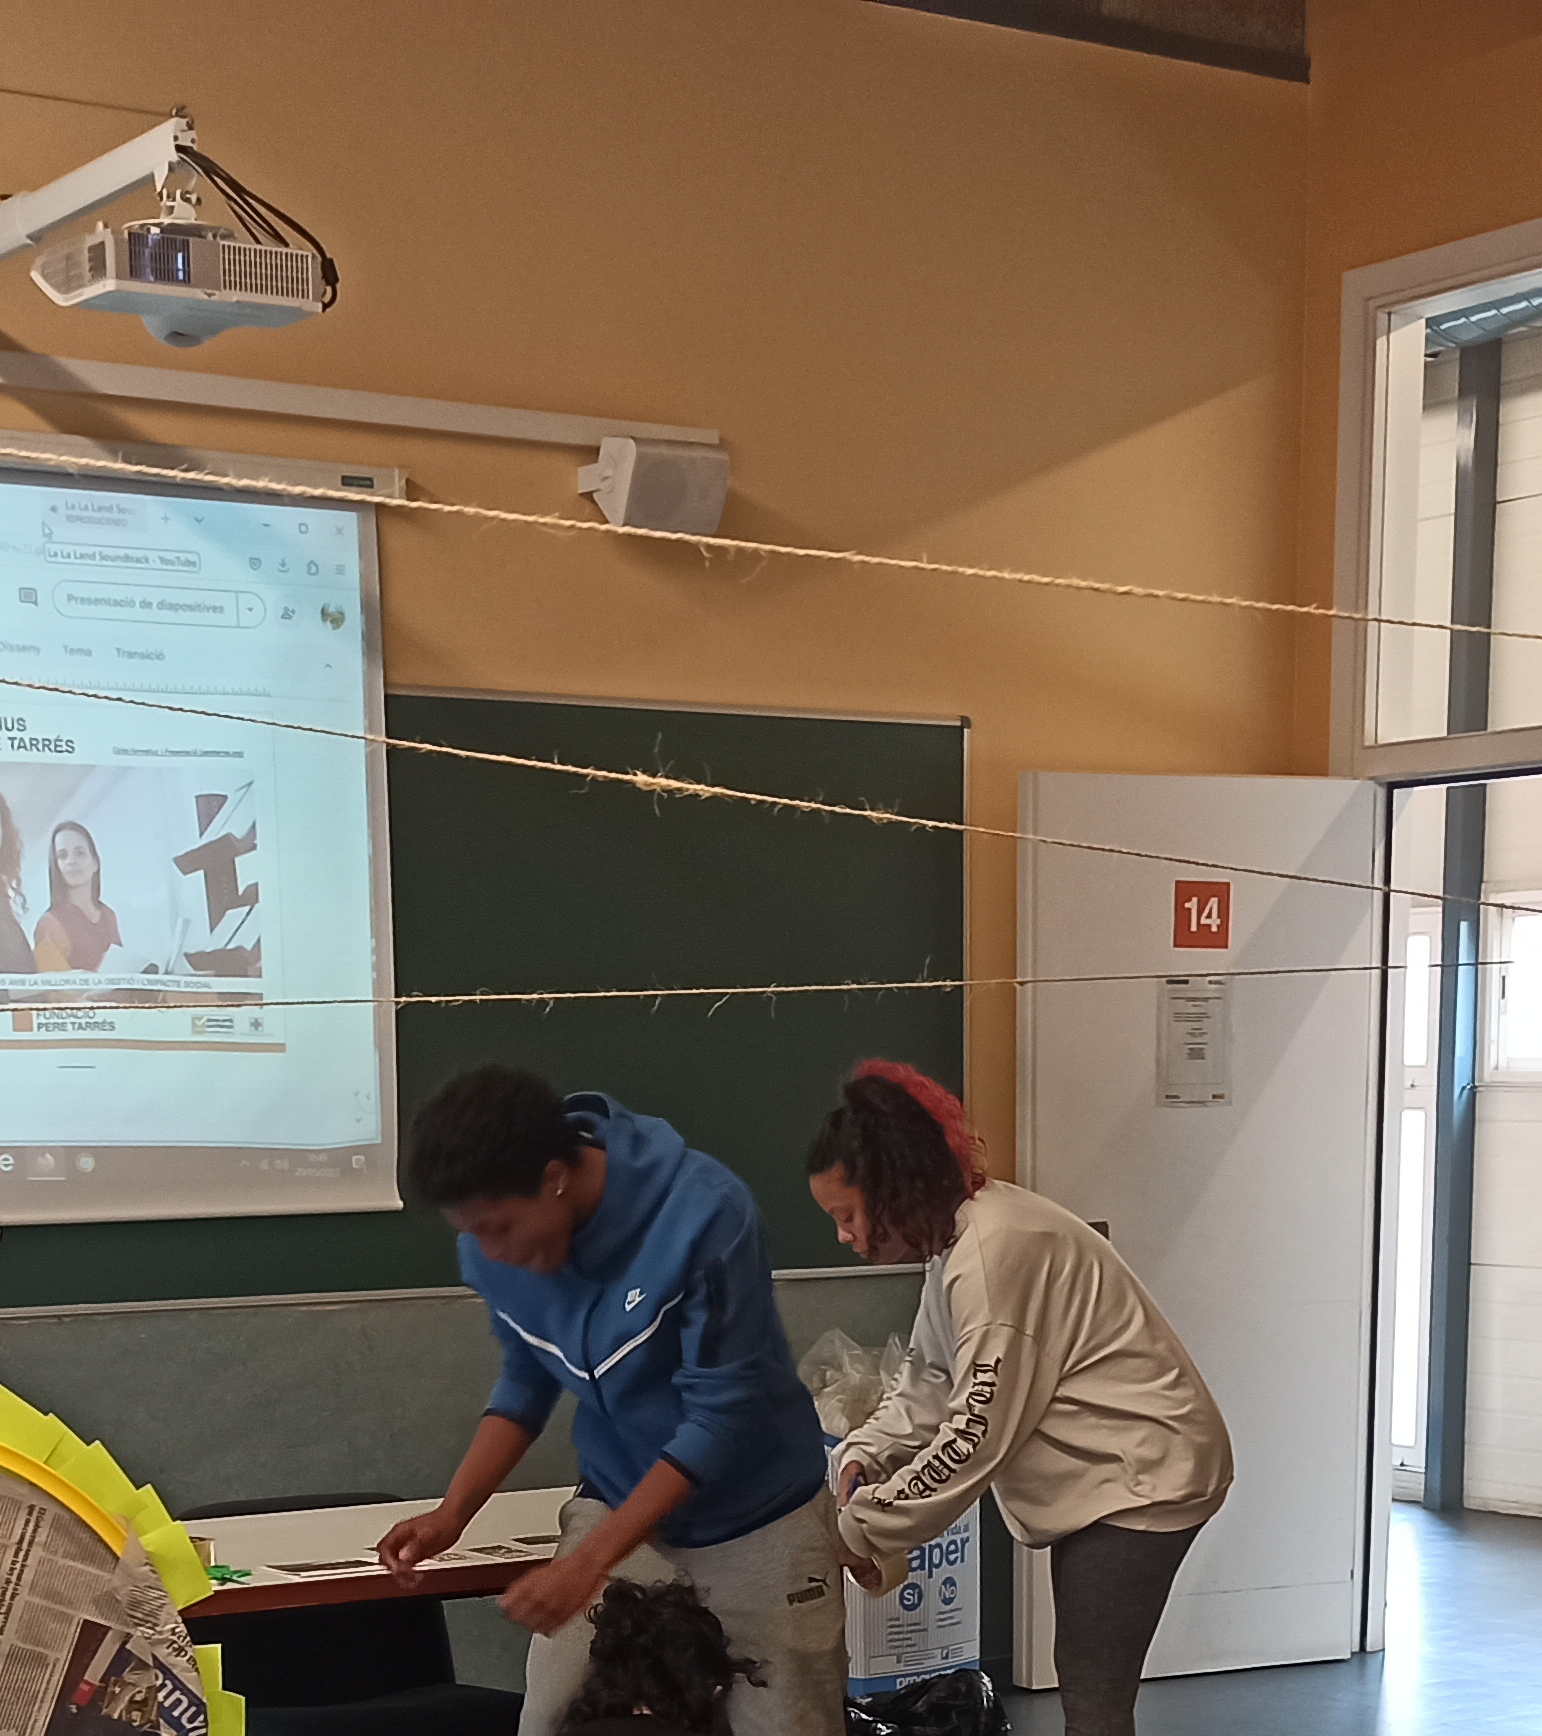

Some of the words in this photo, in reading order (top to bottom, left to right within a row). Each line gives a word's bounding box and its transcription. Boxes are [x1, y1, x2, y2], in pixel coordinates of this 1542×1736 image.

[67, 592, 136, 609] Presentació
[139, 596, 153, 610] de
[157, 597, 224, 615] diapositives
[115, 647, 164, 661] Transició
[8, 735, 76, 755] TARRÉS
[1183, 896, 1221, 933] 14
[37, 1021, 70, 1032] PERE
[72, 1019, 116, 1032] TARRÉS
[905, 1536, 970, 1579] aper
[787, 1584, 826, 1606] PUMA
[903, 1588, 920, 1604] Sí
[940, 1584, 957, 1600] No
